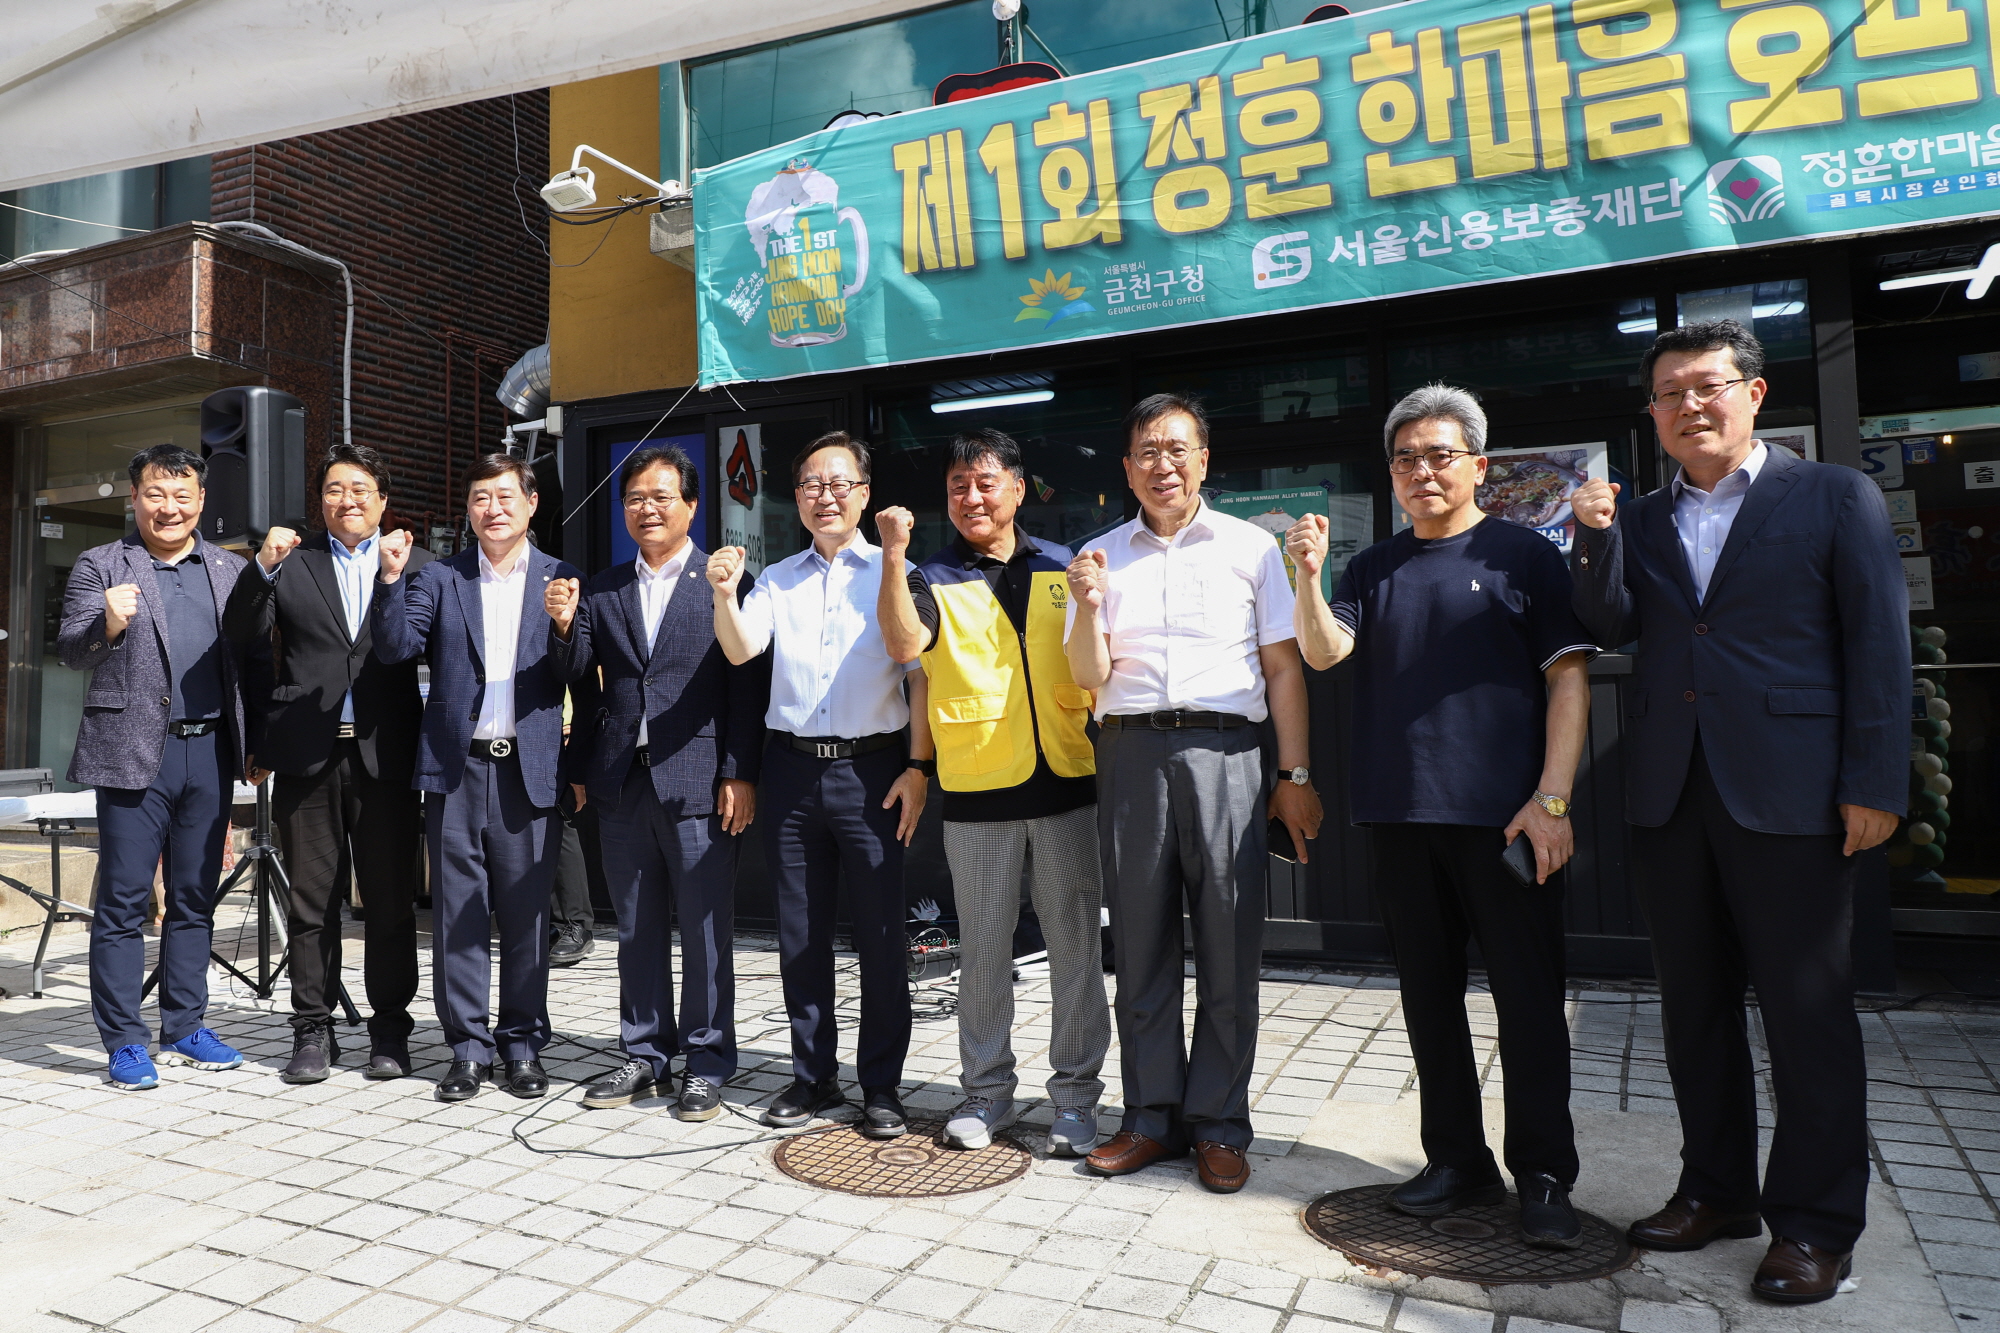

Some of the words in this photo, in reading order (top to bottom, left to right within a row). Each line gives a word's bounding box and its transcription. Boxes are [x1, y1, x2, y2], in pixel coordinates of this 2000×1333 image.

[892, 98, 1124, 274] 제1회
[769, 235, 803, 258] THE
[797, 217, 812, 251] 1
[813, 229, 838, 249] ST
[1327, 177, 1687, 267] 서울신용보증재단
[765, 254, 797, 284] JUNG
[803, 247, 842, 277] HOON
[1103, 264, 1204, 304] 금천구청
[1104, 260, 1146, 275] 서울특별시
[771, 274, 839, 307] HANMAUM
[1177, 295, 1206, 306] OFFICE
[767, 303, 811, 334] HOPE
[815, 298, 847, 327] DAY
